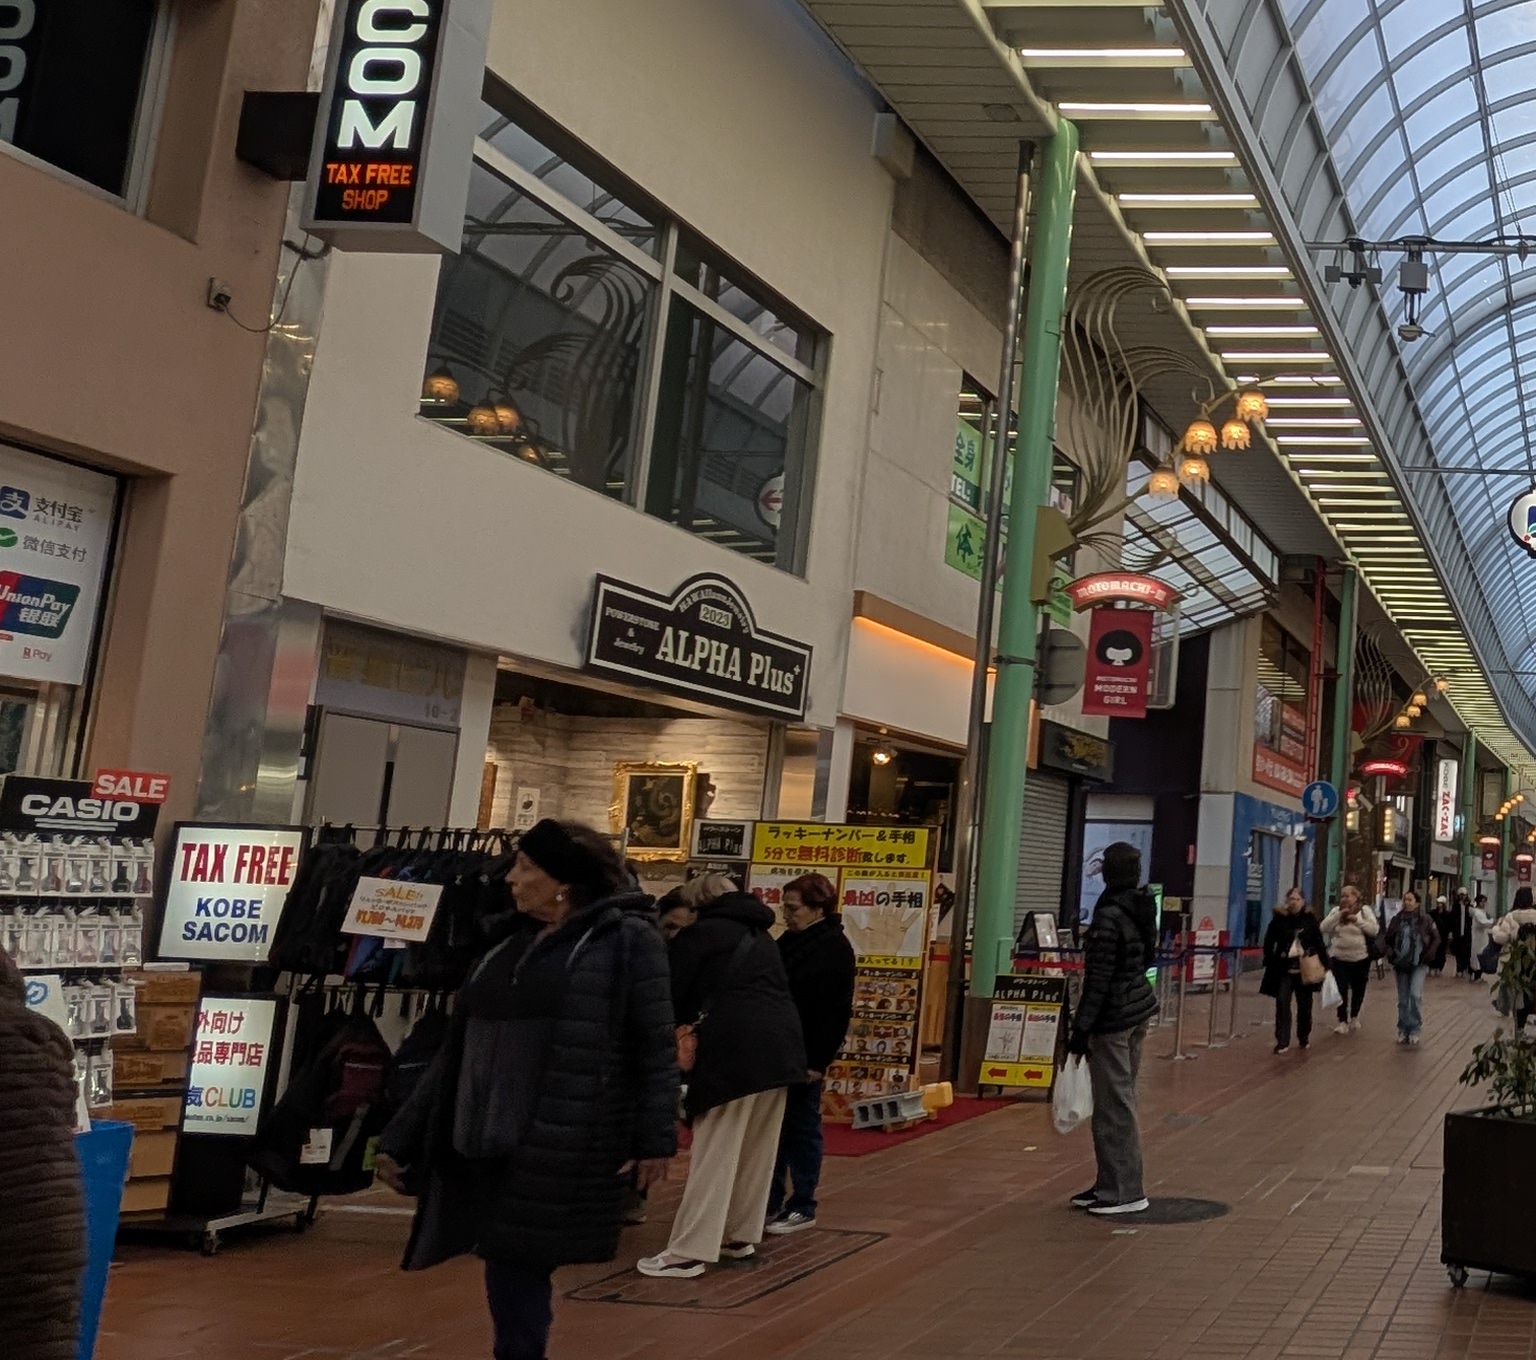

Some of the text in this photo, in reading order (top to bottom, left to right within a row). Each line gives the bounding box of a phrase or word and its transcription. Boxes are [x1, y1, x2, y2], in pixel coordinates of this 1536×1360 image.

[326, 163, 412, 186] TAX FREE
[342, 189, 389, 210] SHOP
[33, 497, 84, 524] 支付宝
[33, 515, 81, 533] ALIPAY
[22, 535, 87, 563] 微信支付
[0, 584, 72, 616] UnionPay
[33, 648, 52, 663] Pay
[655, 625, 742, 682] ALPHA
[95, 774, 169, 800] SALE
[21, 794, 140, 822] CASIO
[1440, 791, 1451, 837] ZAC-ZAC
[767, 826, 916, 845] ラッキーナンバー&手相
[180, 842, 295, 886] TAX FREE
[194, 897, 264, 920] KOBE
[182, 921, 270, 944] SACOM
[994, 988, 1027, 1000] ALPHA
[196, 1009, 245, 1034] 外向け
[192, 1040, 265, 1067] 品専門店
[185, 1085, 257, 1109] 気CLUB
